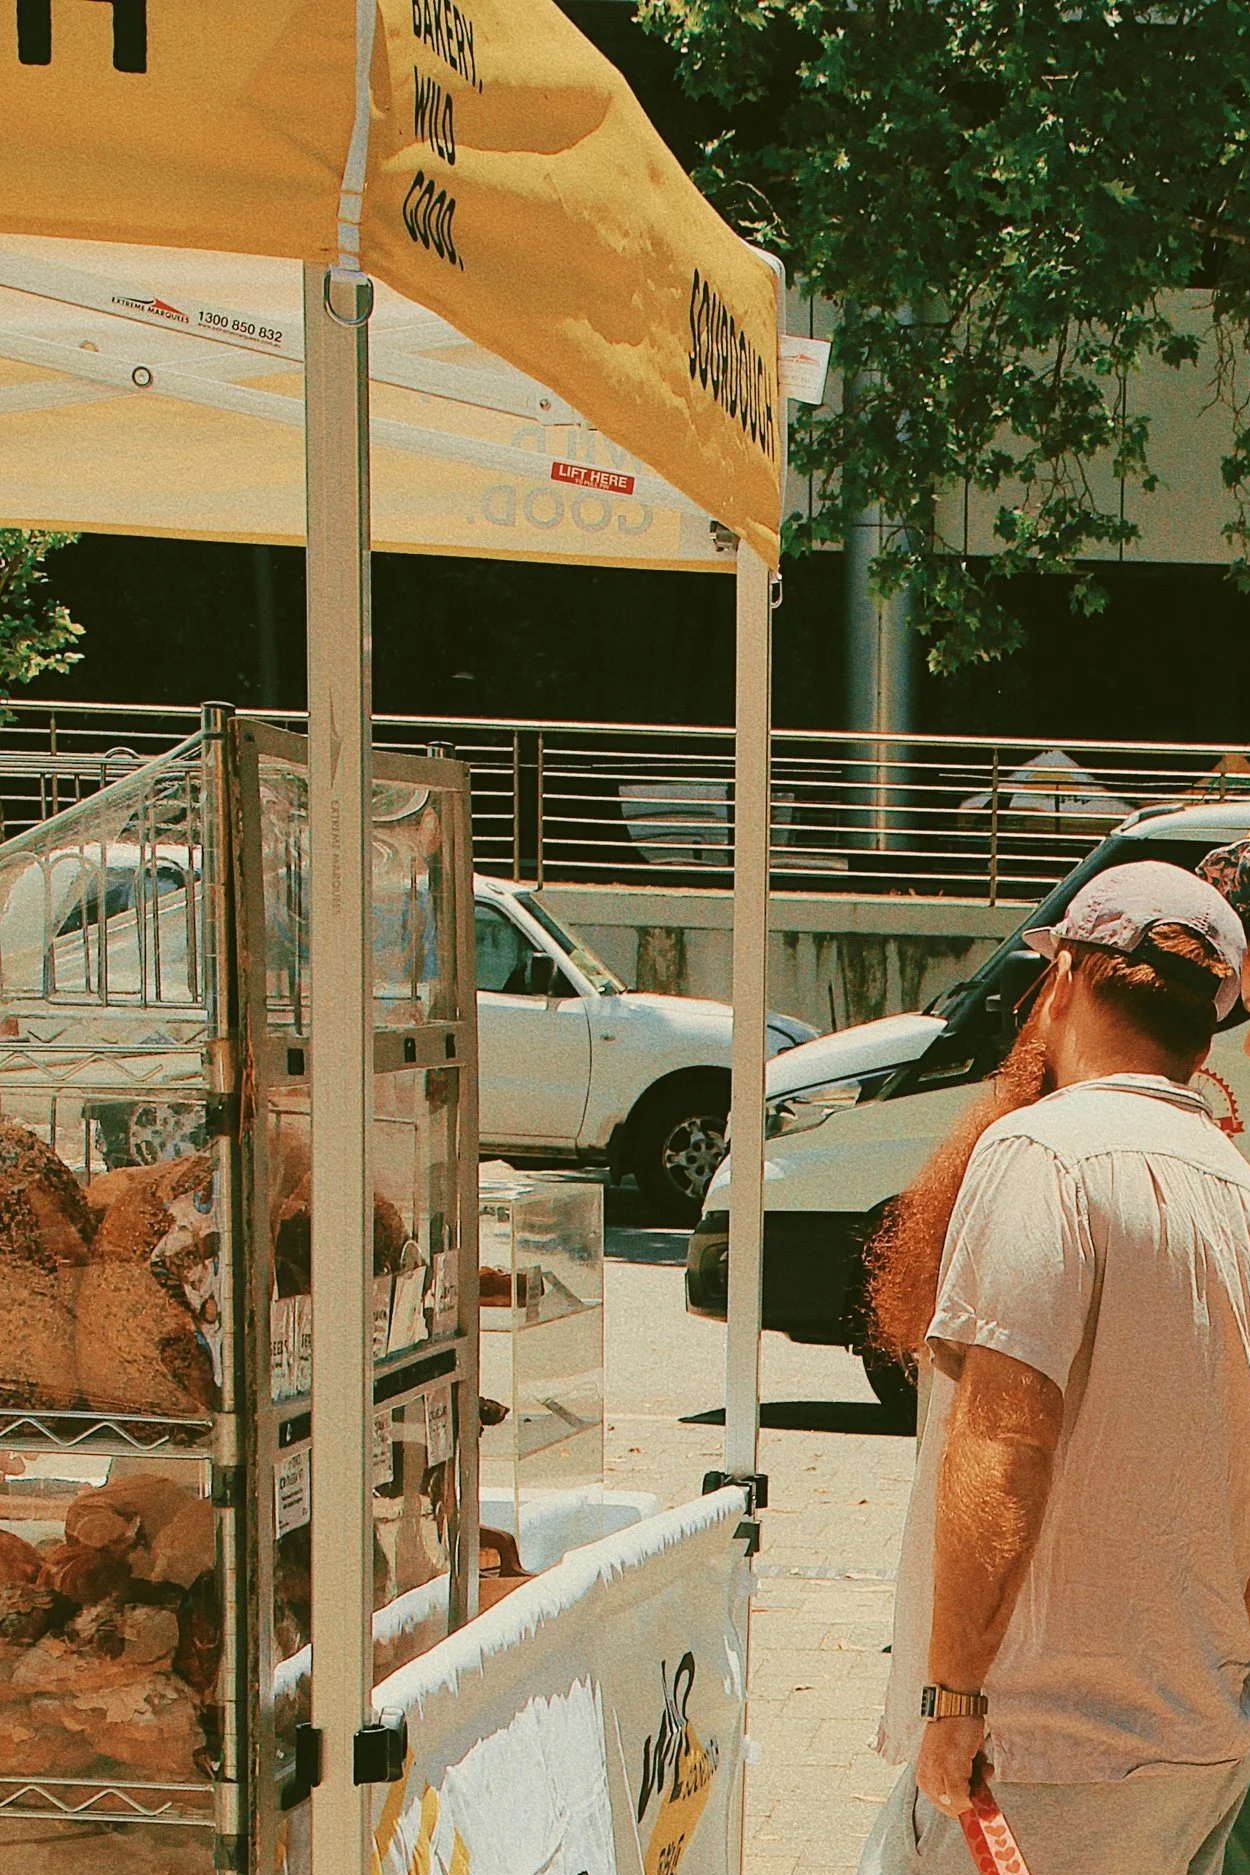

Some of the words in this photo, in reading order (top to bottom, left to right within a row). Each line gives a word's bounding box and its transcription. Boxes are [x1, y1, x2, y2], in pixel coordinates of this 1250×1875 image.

[414, 65, 456, 166] WILD
[402, 170, 465, 272] GOOD.
[111, 296, 145, 311] EXTREME
[147, 306, 190, 324] MARQUEES
[198, 311, 229, 328] 1300
[231, 319, 256, 335] 850
[258, 326, 283, 343] 832
[688, 268, 775, 463] SOURDOUGH
[558, 464, 588, 480] LIFT
[590, 471, 628, 488] HERE
